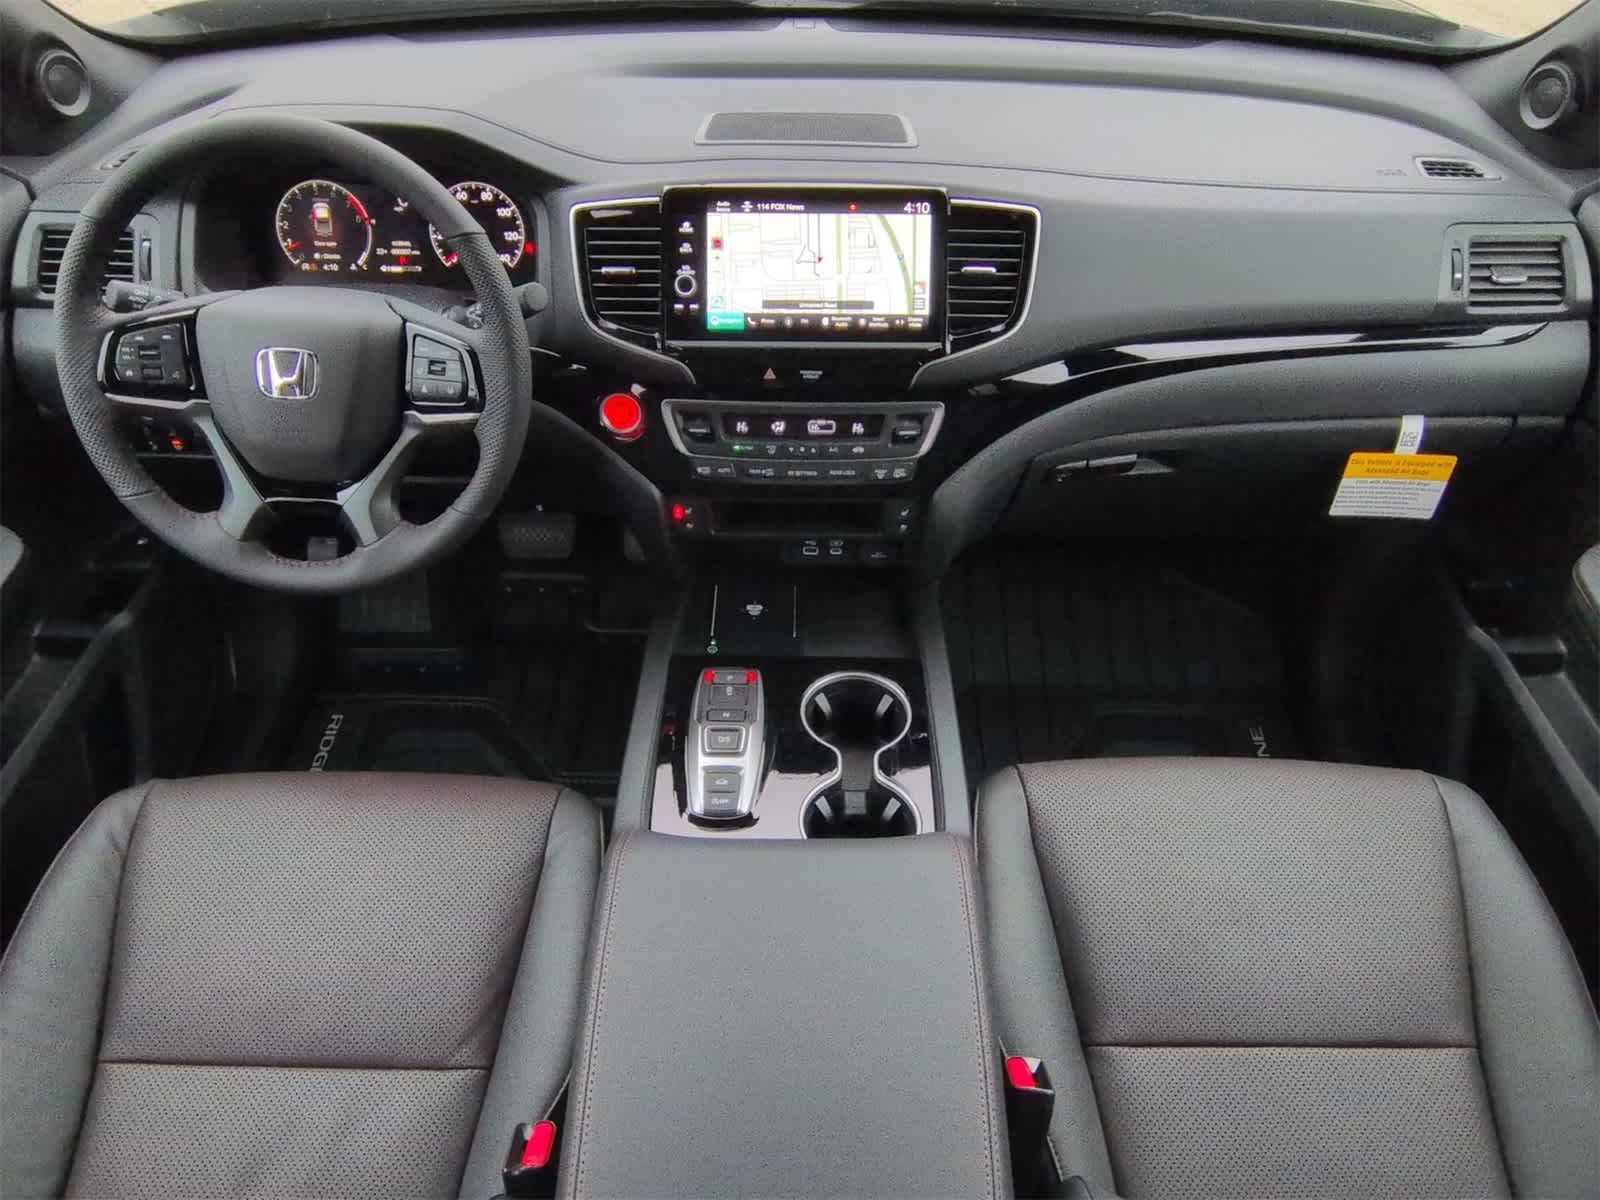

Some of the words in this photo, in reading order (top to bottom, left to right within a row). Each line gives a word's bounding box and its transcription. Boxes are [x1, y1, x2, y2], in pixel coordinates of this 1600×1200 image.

[480, 192, 493, 201] 80
[496, 207, 511, 217] 100
[903, 202, 930, 214] 4:10
[504, 231, 519, 240] 120
[322, 263, 339, 271] 4:10
